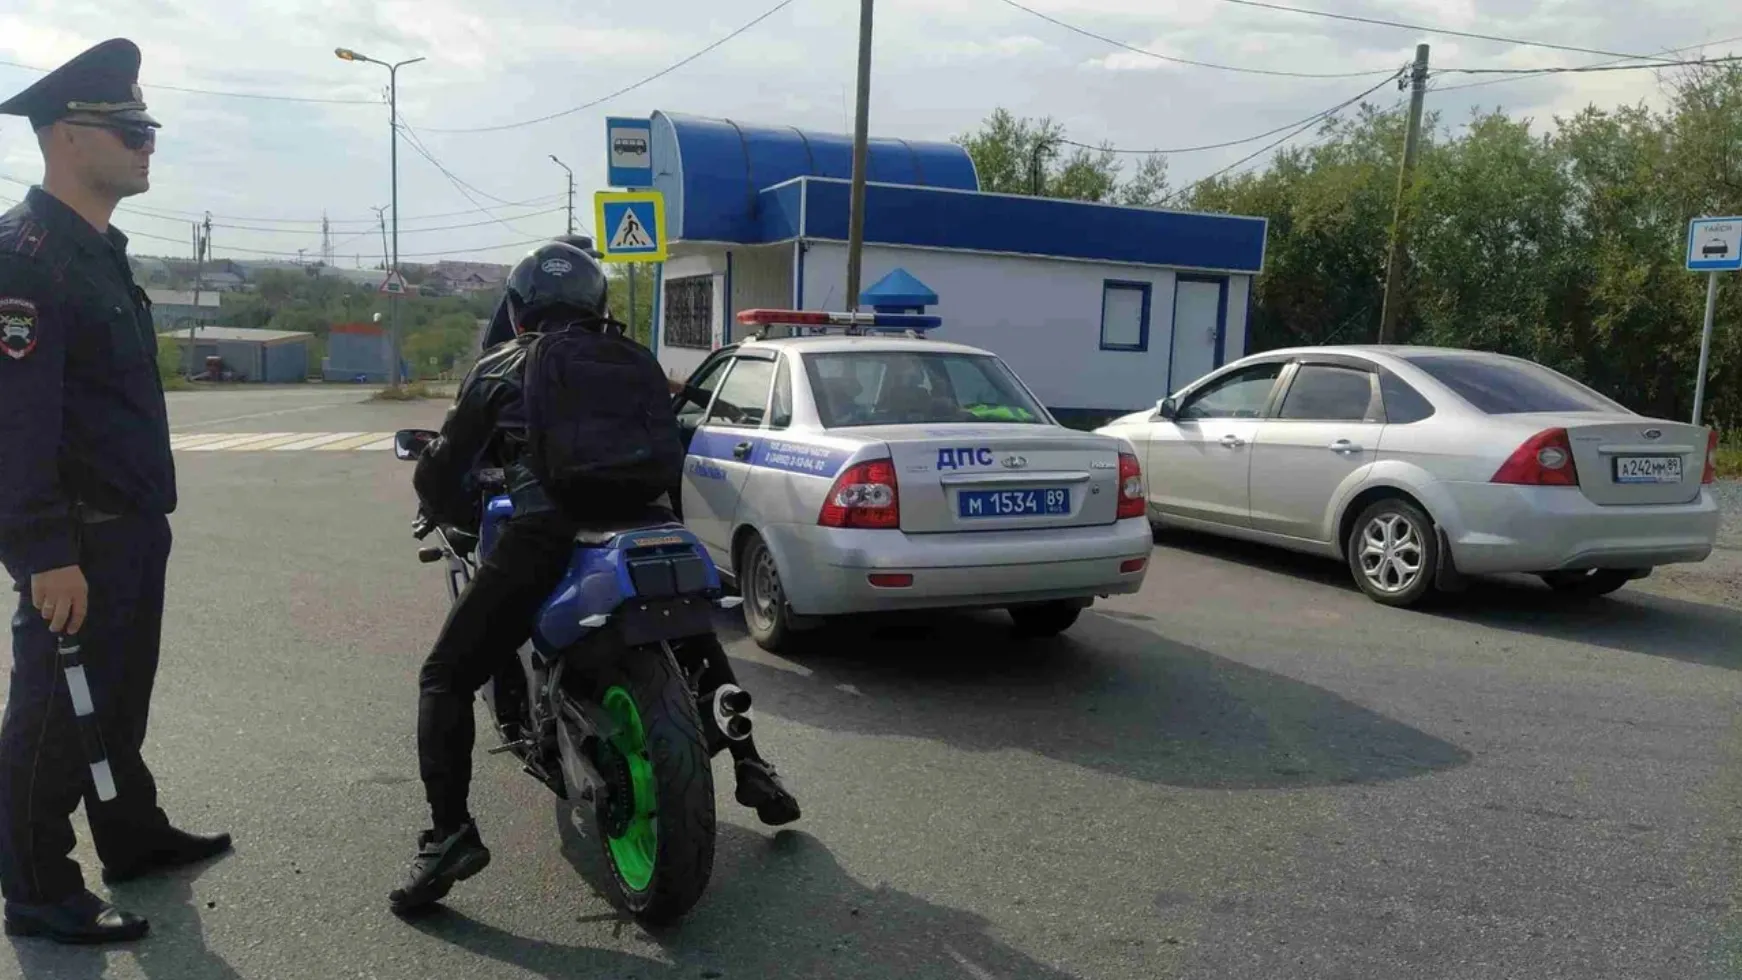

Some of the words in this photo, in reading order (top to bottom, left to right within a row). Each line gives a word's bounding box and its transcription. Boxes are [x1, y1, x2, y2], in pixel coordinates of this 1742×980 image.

[937, 448, 993, 470] ДПС
[990, 491, 1037, 514] 1534
[1047, 490, 1064, 505] 89
